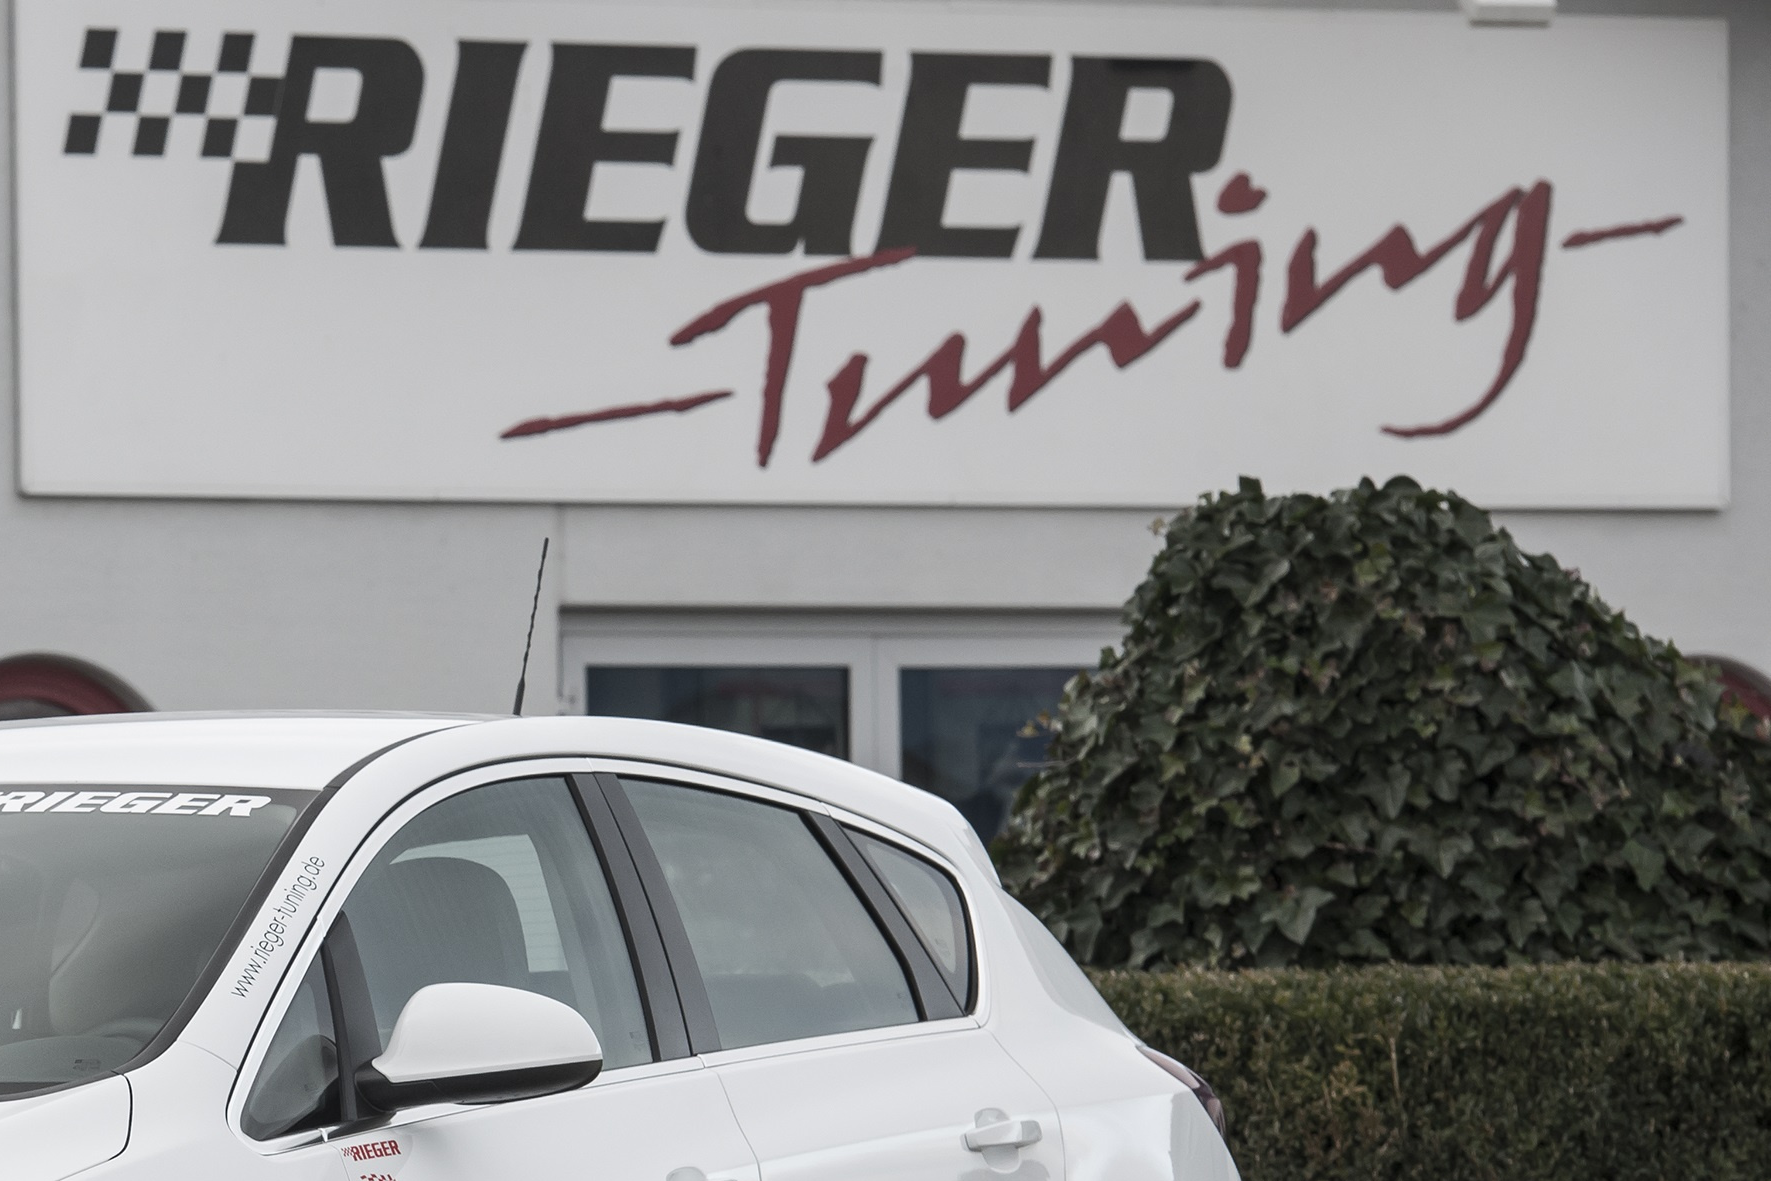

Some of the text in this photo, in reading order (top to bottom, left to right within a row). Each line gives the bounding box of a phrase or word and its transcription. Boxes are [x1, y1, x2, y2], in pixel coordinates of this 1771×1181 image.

[215, 34, 1233, 261] RIEGER
[501, 173, 1684, 467] Tuning
[231, 856, 325, 998] www.rieger-tuning.de
[351, 1139, 402, 1162] RIEGER
